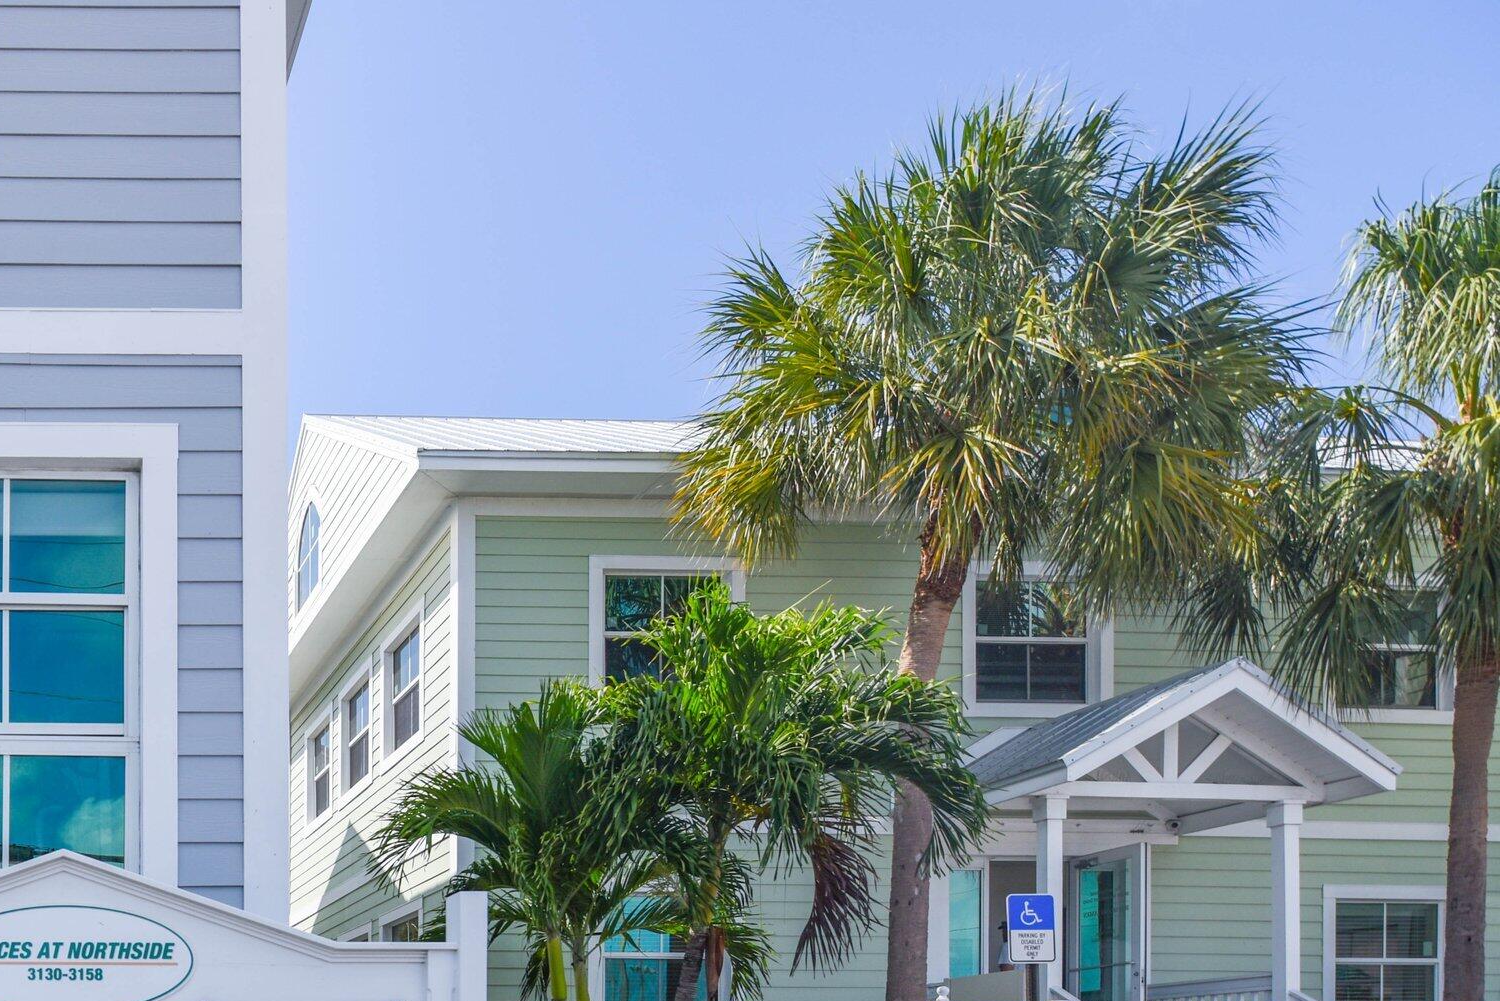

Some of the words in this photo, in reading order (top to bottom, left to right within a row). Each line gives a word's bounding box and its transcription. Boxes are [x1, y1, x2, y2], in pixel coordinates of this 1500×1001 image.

[37, 942, 63, 959] AT
[67, 942, 175, 960] NORTHSIDE
[27, 968, 103, 981] 3130-3158
